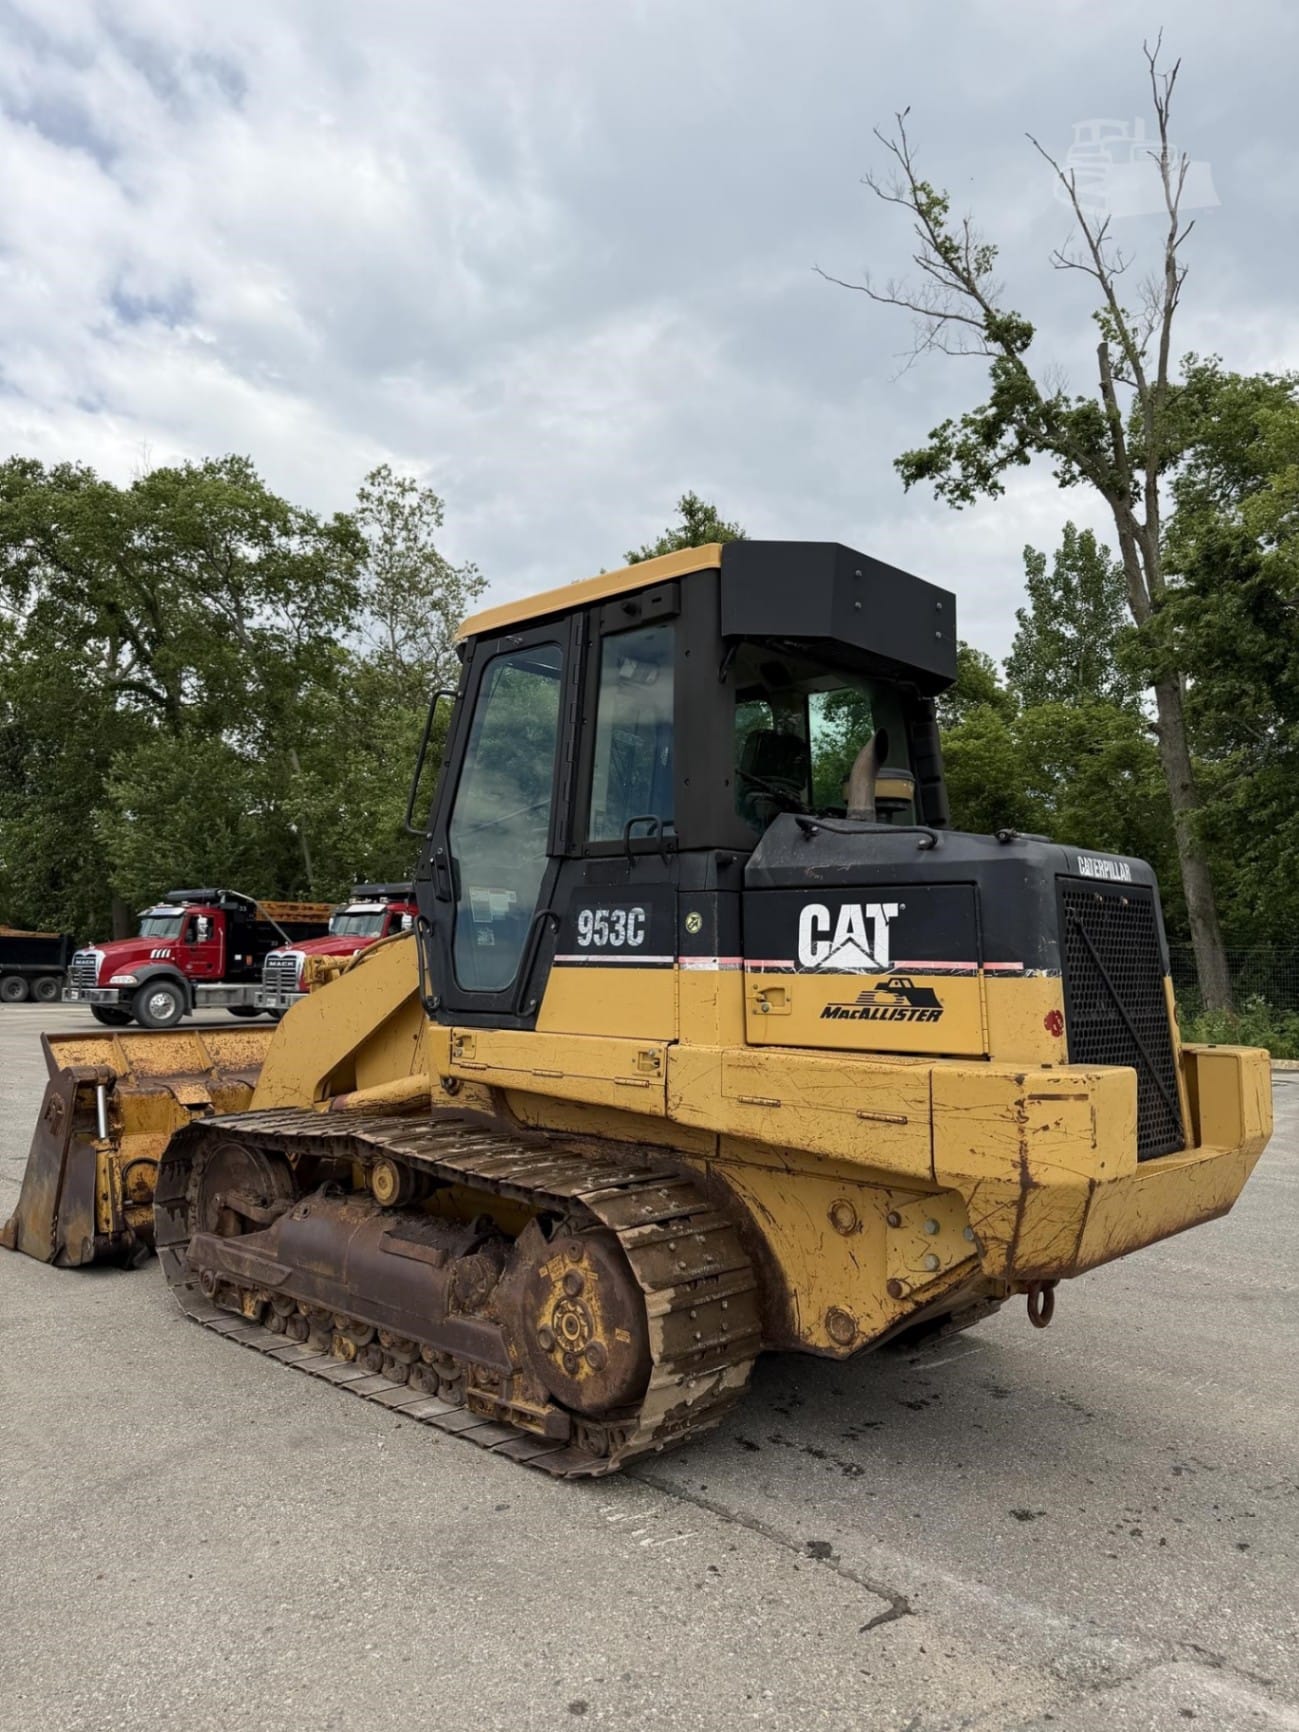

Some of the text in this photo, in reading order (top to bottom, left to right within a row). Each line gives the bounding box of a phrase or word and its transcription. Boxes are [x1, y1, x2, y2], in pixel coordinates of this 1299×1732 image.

[1077, 855, 1132, 882] CATERPILLAR
[577, 907, 646, 947] 953C
[798, 902, 899, 968] CAT
[820, 1006, 944, 1022] MacALLISTER
